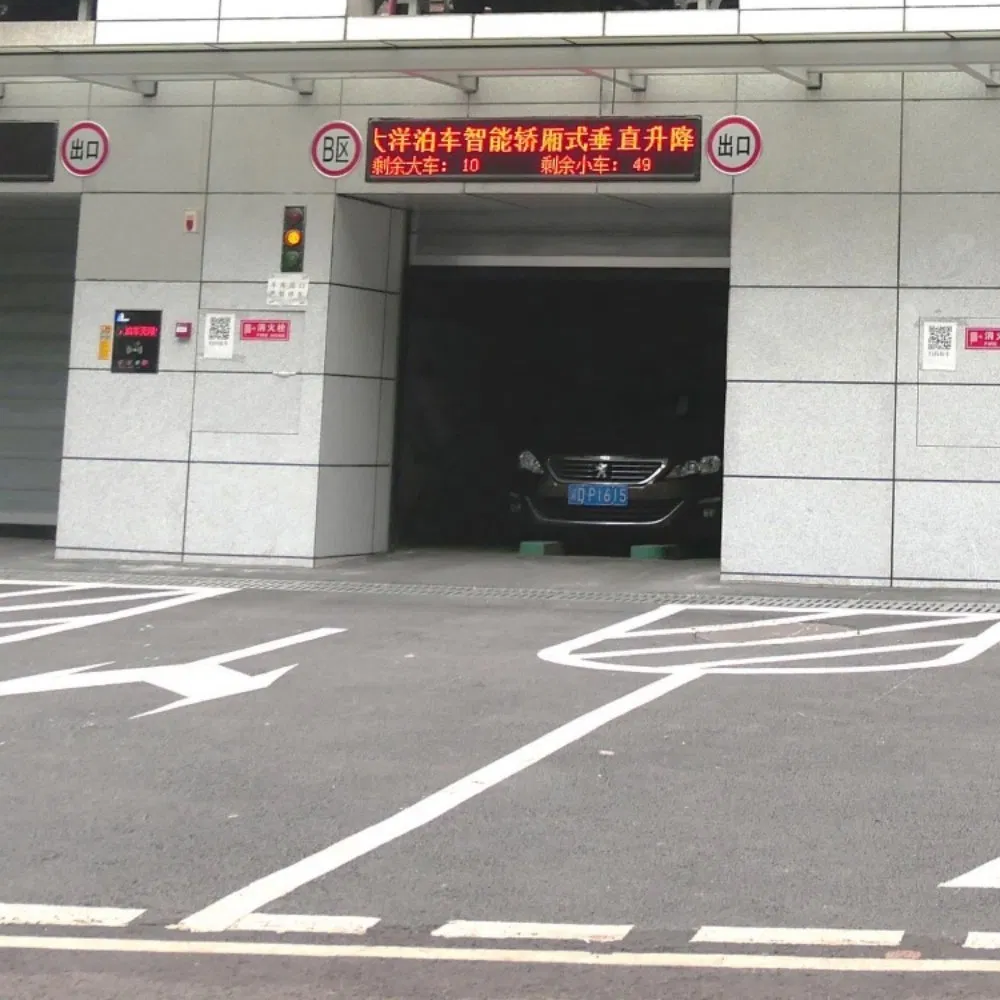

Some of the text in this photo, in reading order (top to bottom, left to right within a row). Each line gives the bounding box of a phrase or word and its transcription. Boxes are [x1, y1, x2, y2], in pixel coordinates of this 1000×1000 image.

[69, 138, 99, 160] 出口
[322, 136, 350, 164] B区
[717, 133, 752, 158] 出口
[462, 158, 480, 172] 10
[632, 157, 652, 171] 49
